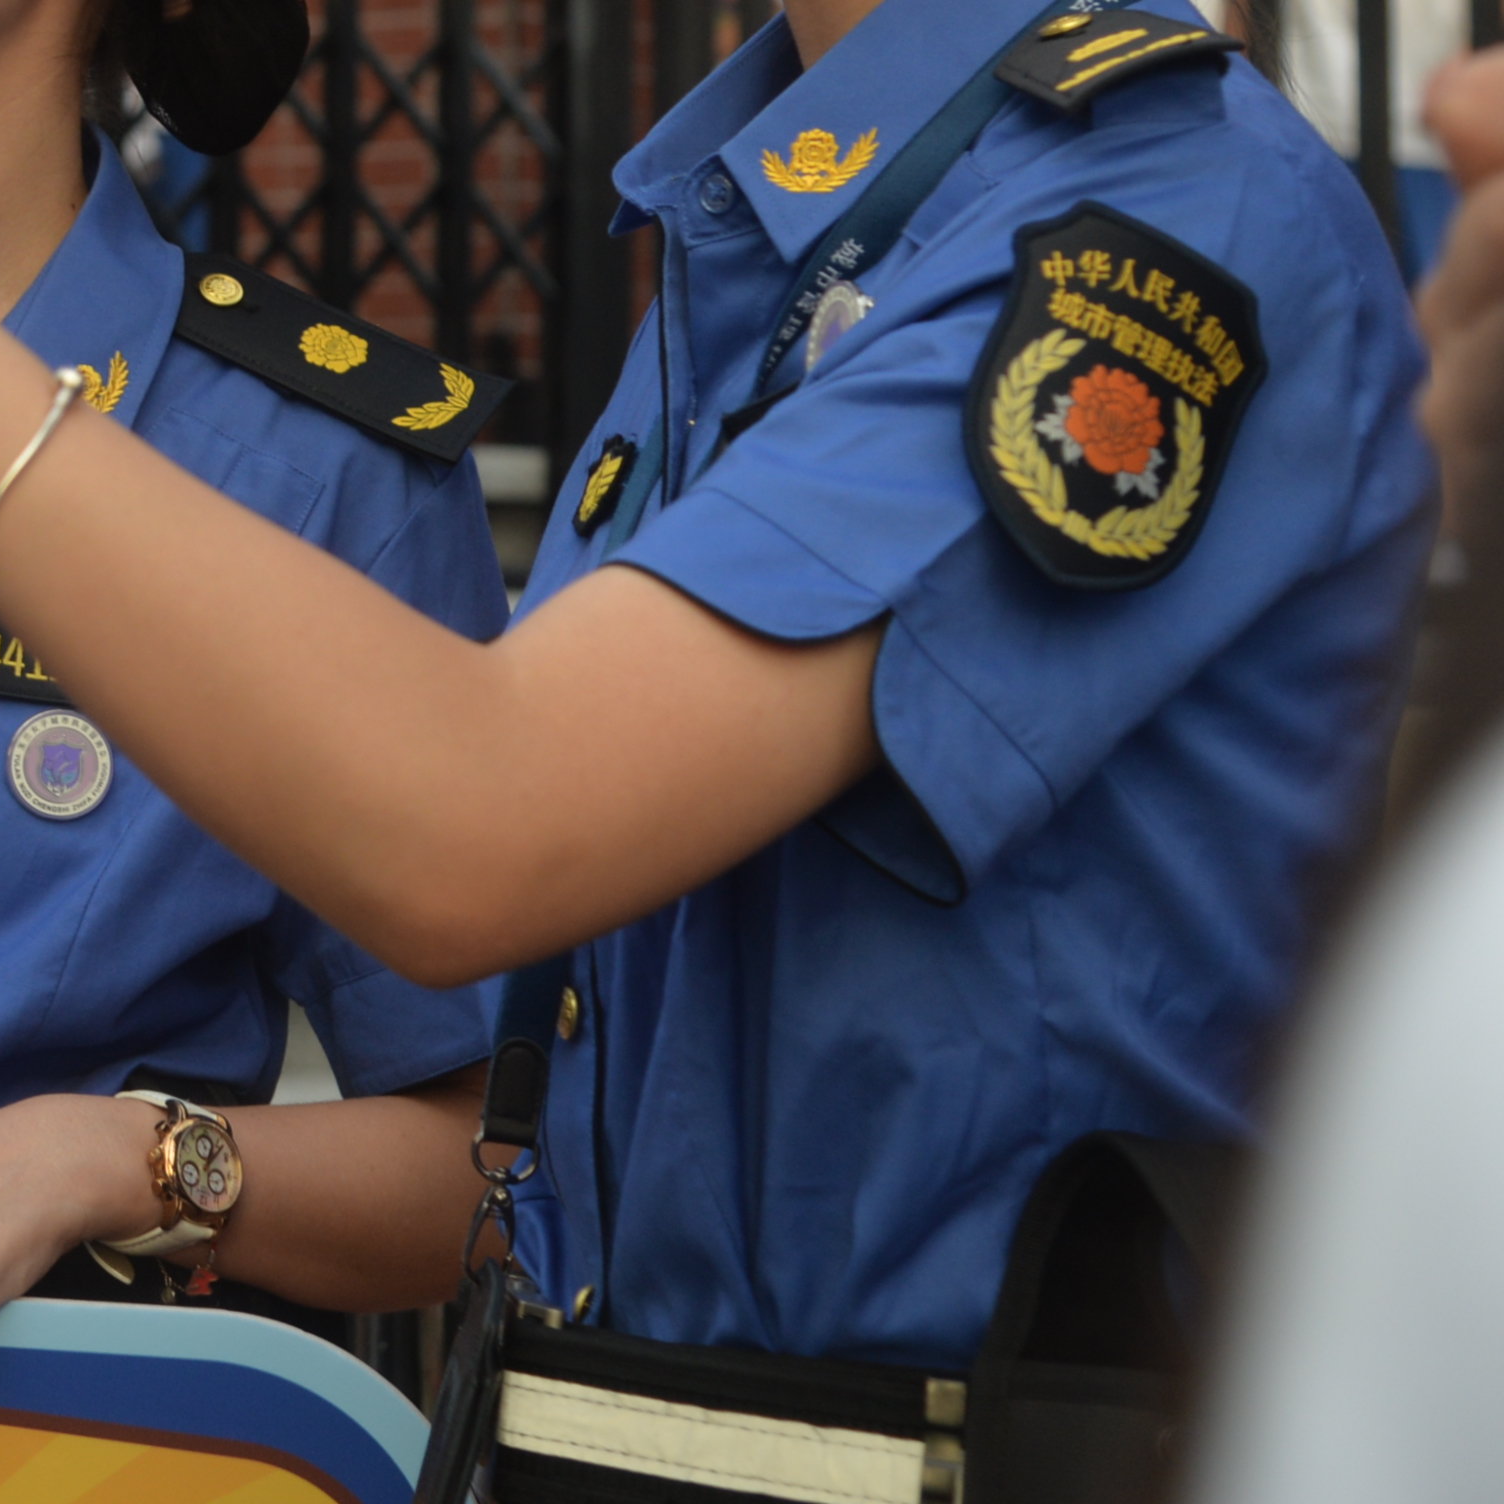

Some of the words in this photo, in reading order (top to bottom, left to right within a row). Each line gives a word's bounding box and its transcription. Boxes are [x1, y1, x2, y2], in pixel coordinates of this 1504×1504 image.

[1041, 250, 1244, 386] 中华人民共和国
[1047, 288, 1219, 407] 城市管理执法
